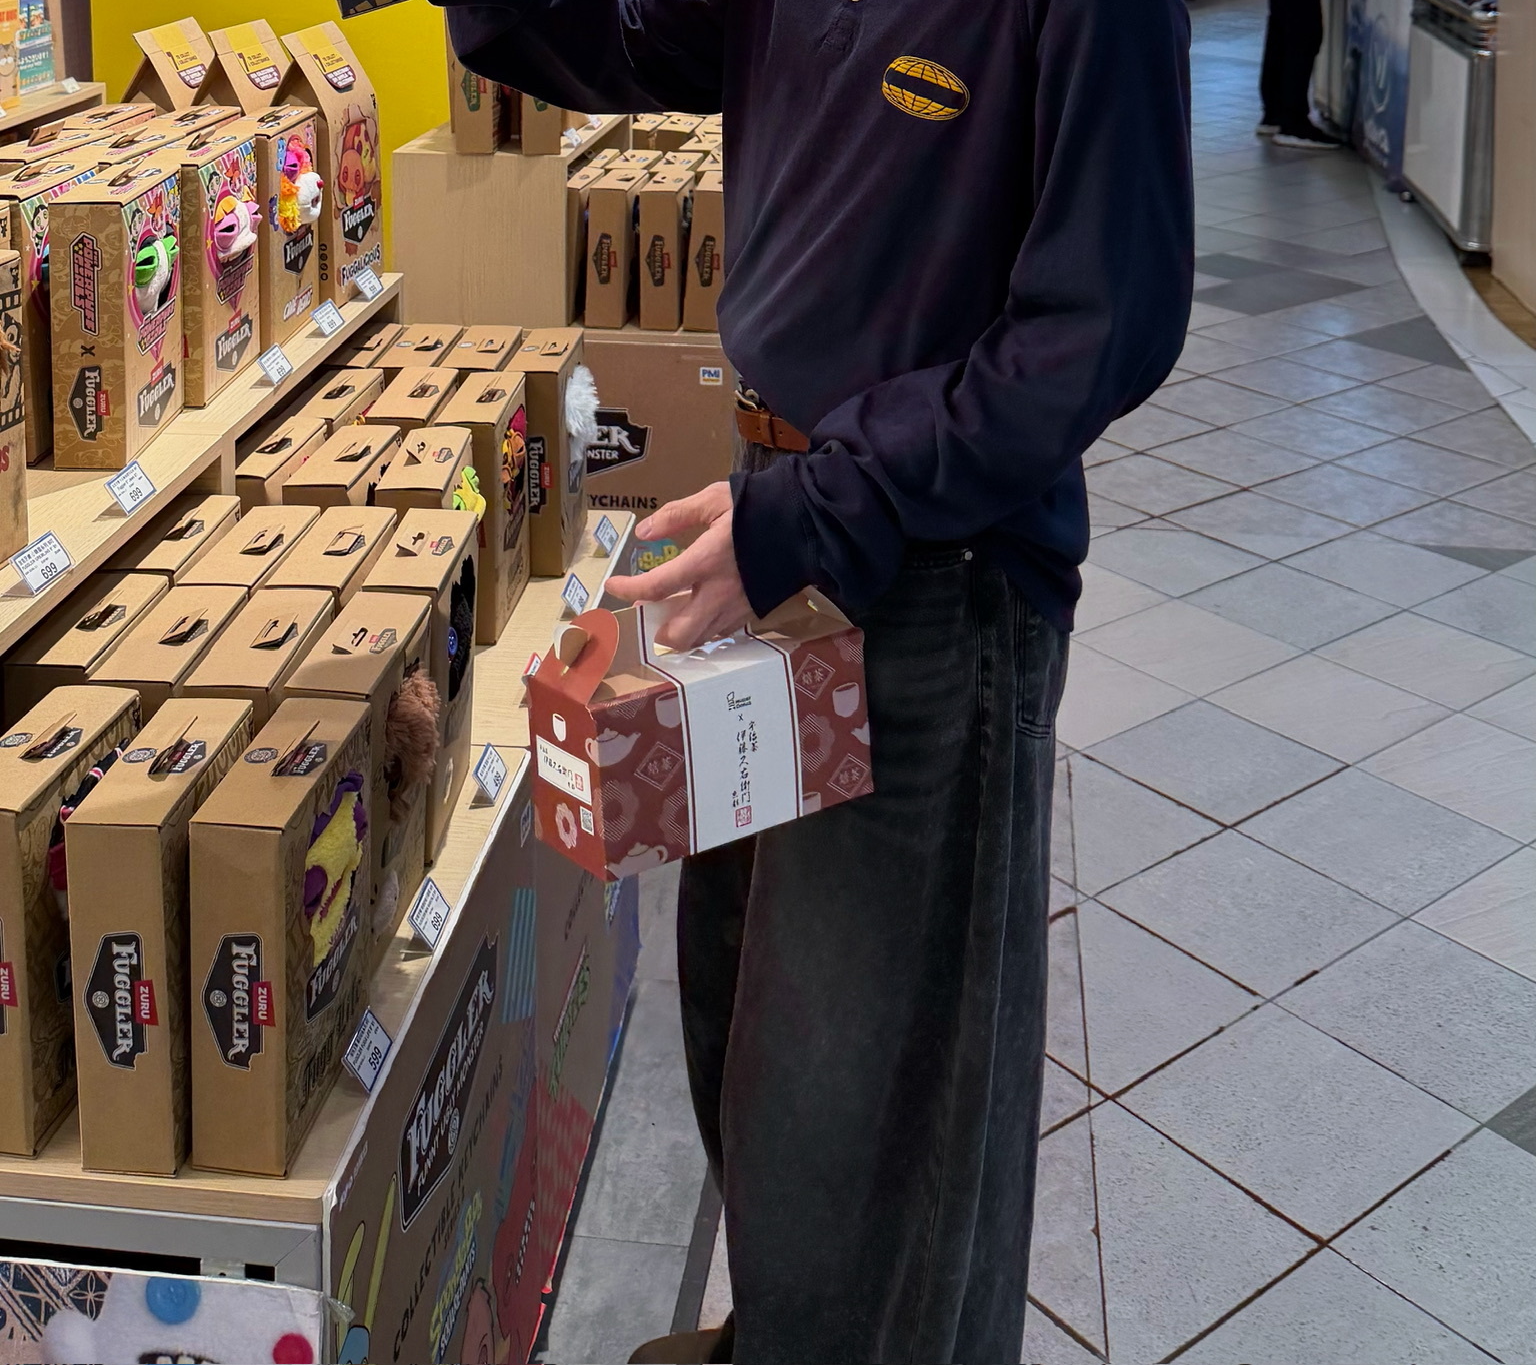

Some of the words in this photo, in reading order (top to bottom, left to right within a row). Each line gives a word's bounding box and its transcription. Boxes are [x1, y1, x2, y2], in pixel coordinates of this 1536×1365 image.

[344, 203, 375, 233] FUGGLER
[74, 253, 86, 310] GIRLS
[83, 236, 96, 333] POWERPUFF
[217, 323, 252, 361] FUGGLER
[84, 369, 100, 438] FUGGLER
[139, 372, 175, 417] FUGGLER
[529, 440, 544, 507] FUGGLER
[129, 487, 144, 502] 699
[40, 562, 59, 580] 699
[174, 742, 206, 772] FUGGLER
[293, 745, 325, 775] FUGGLER
[431, 911, 444, 931] 699
[0, 967, 10, 1000] ZURU
[112, 941, 138, 1060] FUGGLER
[227, 942, 257, 1060] FUGGLER
[139, 985, 150, 1020] ZURU
[257, 987, 268, 1020] ZURU
[368, 1045, 383, 1071] 599
[407, 969, 495, 1195] FUGGLER
